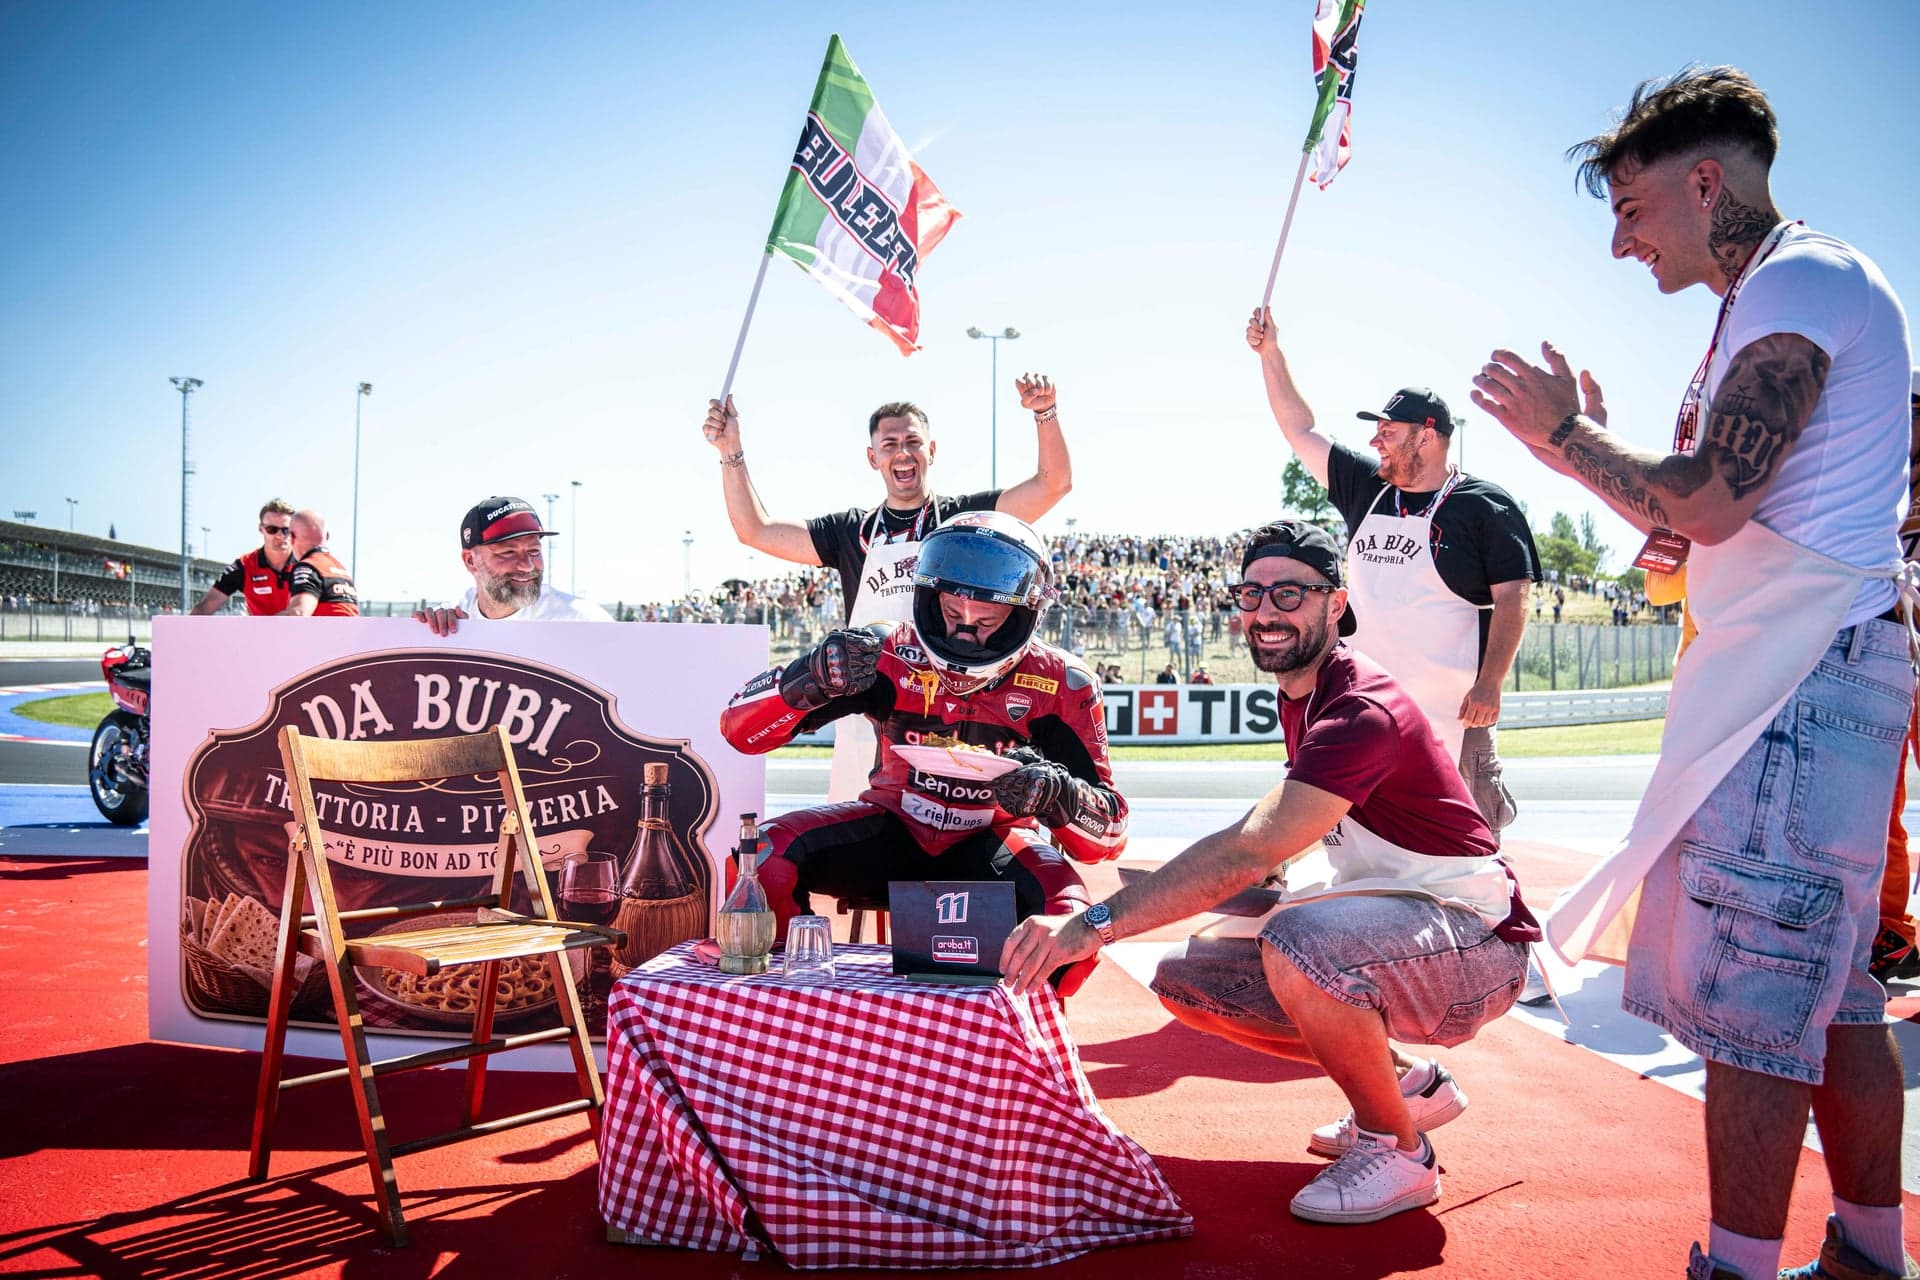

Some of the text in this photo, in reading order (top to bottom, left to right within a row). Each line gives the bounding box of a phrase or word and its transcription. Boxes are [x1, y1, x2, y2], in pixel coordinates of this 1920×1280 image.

[1356, 534, 1378, 555] DA
[866, 567, 889, 594] DA
[301, 673, 572, 757] DA BUBI
[1188, 689, 1279, 735] TIS
[914, 769, 993, 800] Lenovo
[264, 773, 425, 834] TRTTORIA
[1074, 808, 1105, 833] Lenovo
[361, 845, 393, 867] PIÙ
[400, 851, 438, 870] BON
[445, 852, 471, 871] AD
[935, 891, 969, 924] 11
[937, 939, 972, 950] aruba.it
